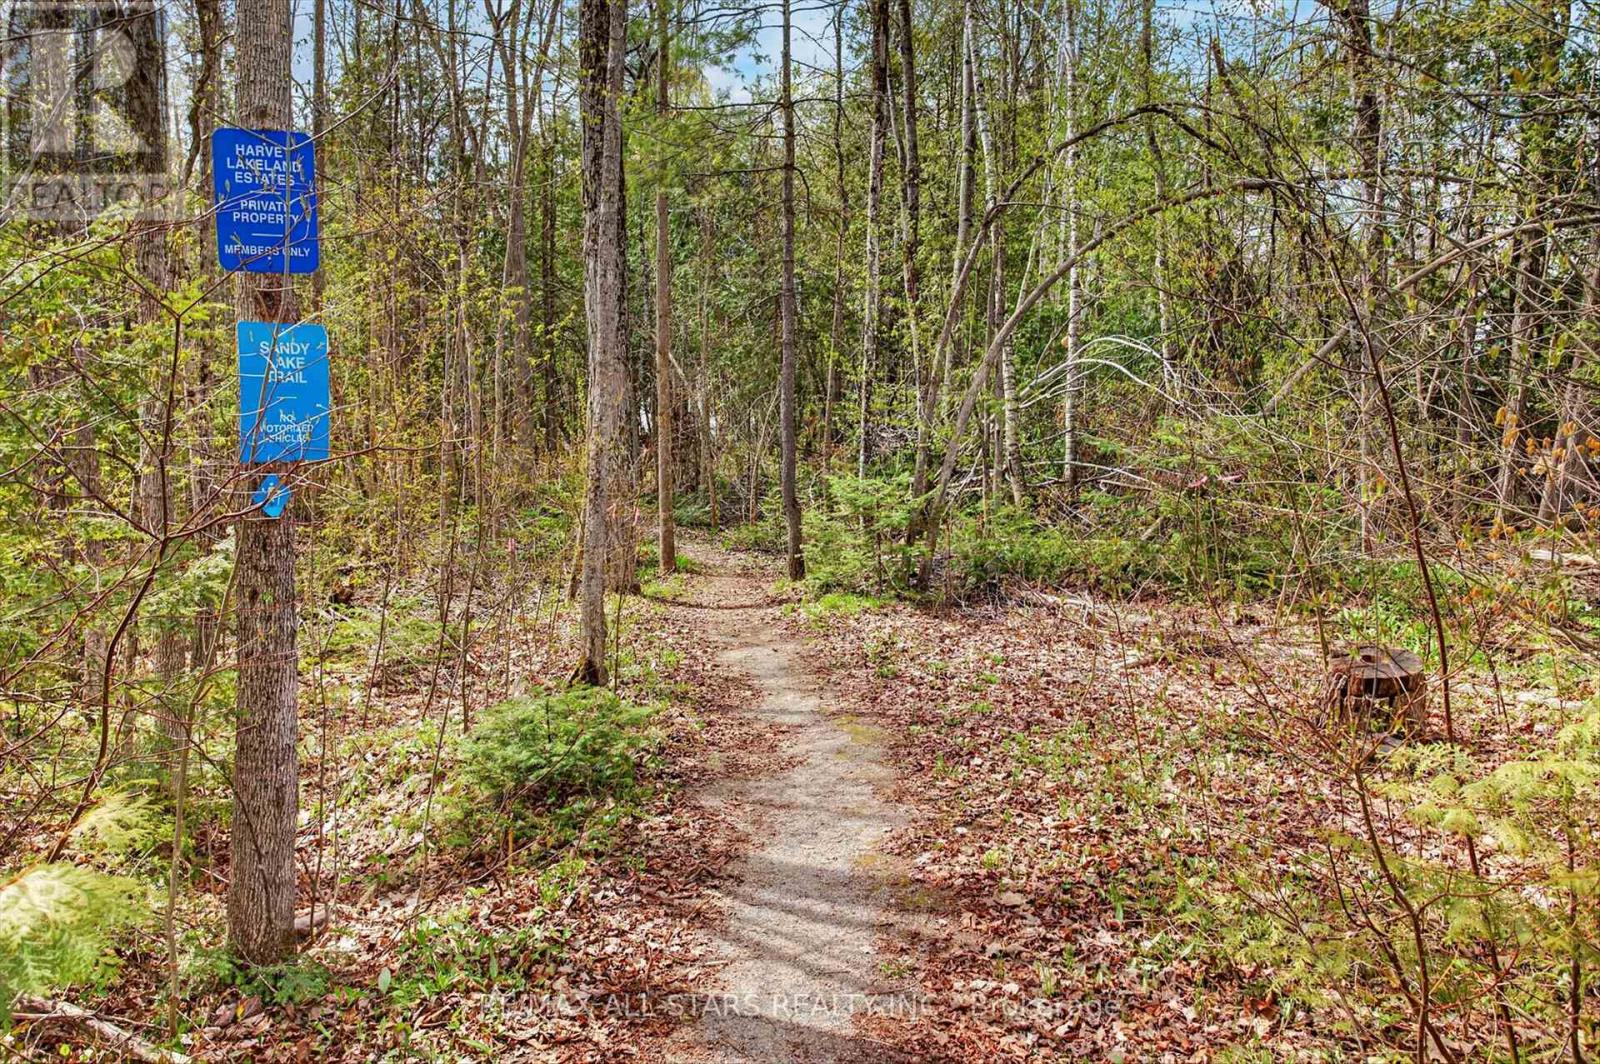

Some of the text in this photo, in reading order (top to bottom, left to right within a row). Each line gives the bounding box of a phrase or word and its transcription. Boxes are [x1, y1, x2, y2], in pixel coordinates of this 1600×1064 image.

[235, 144, 291, 158] HARVE
[234, 171, 295, 186] ESTATES
[240, 200, 291, 213] PRIVAT
[270, 356, 305, 369] AKE
